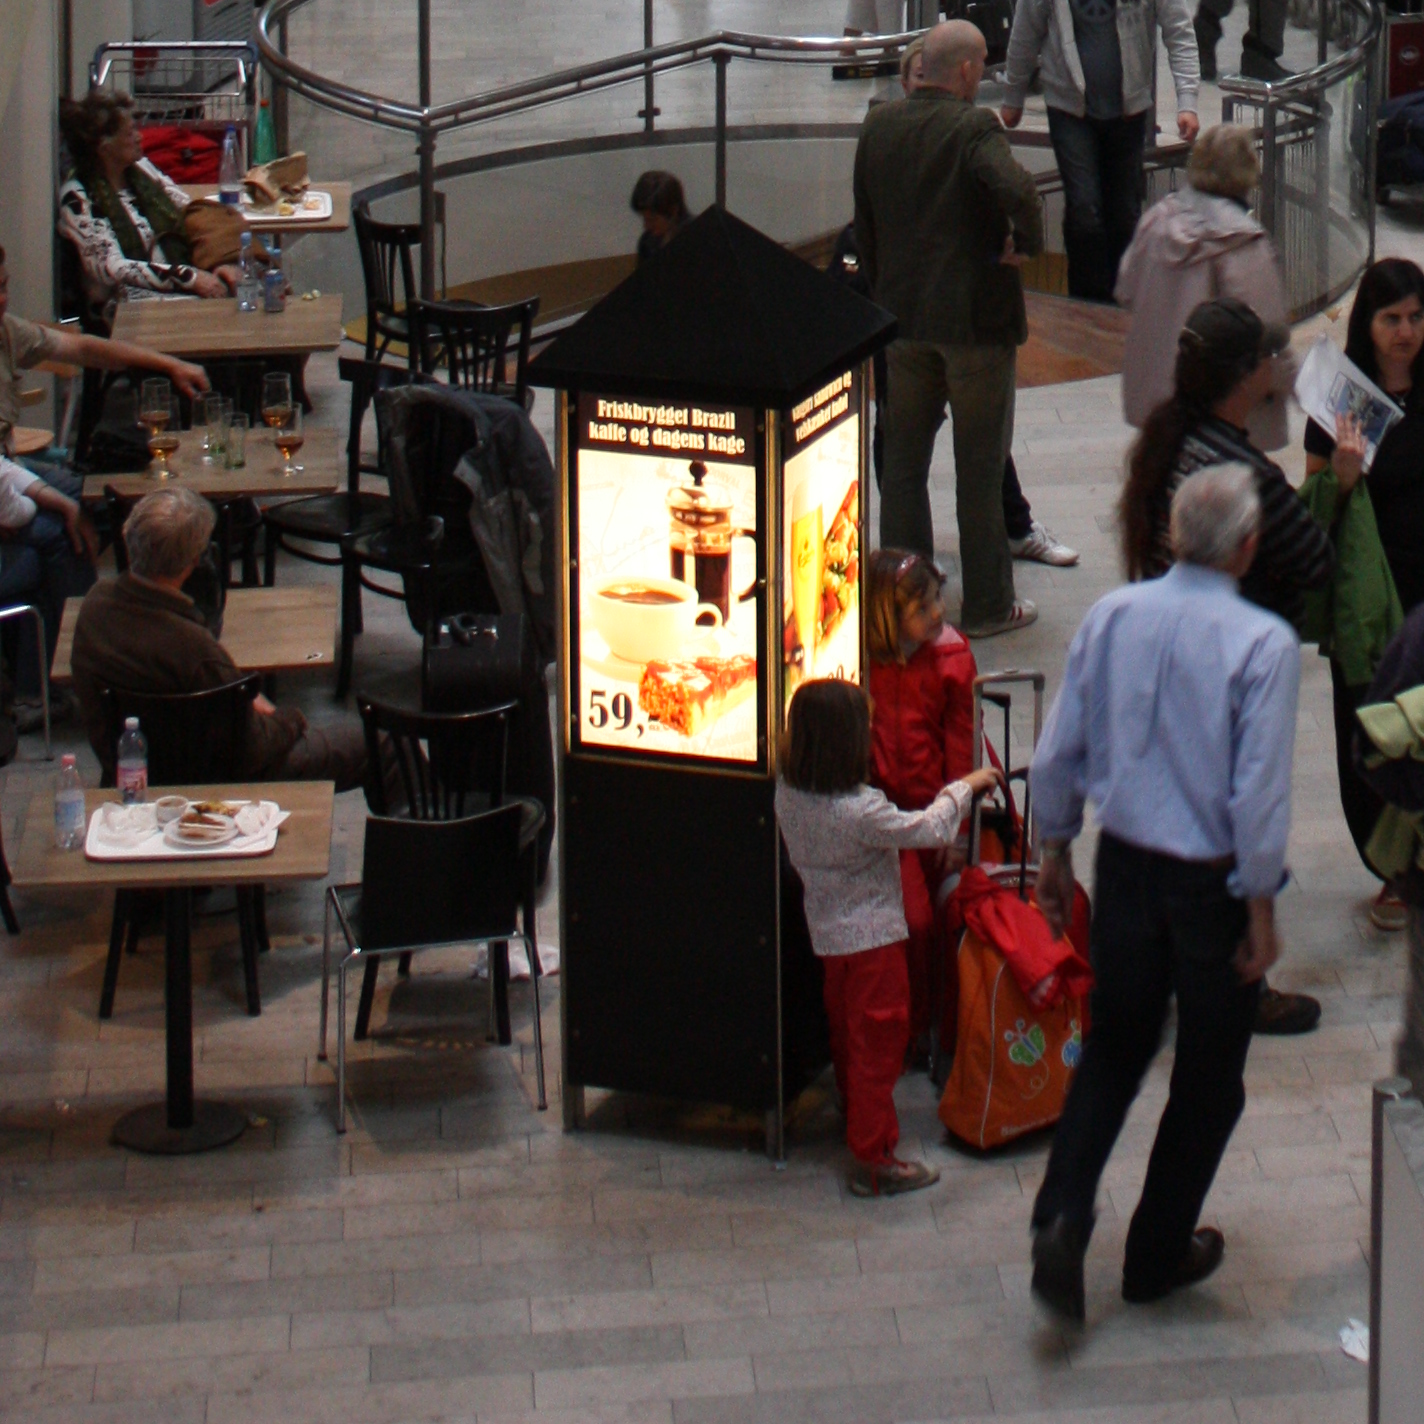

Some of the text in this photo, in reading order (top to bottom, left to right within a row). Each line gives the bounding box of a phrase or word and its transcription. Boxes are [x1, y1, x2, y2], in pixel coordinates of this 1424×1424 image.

[598, 399, 735, 430] Friskbrygget Brazil
[588, 421, 745, 455] kaffe og dagens kage
